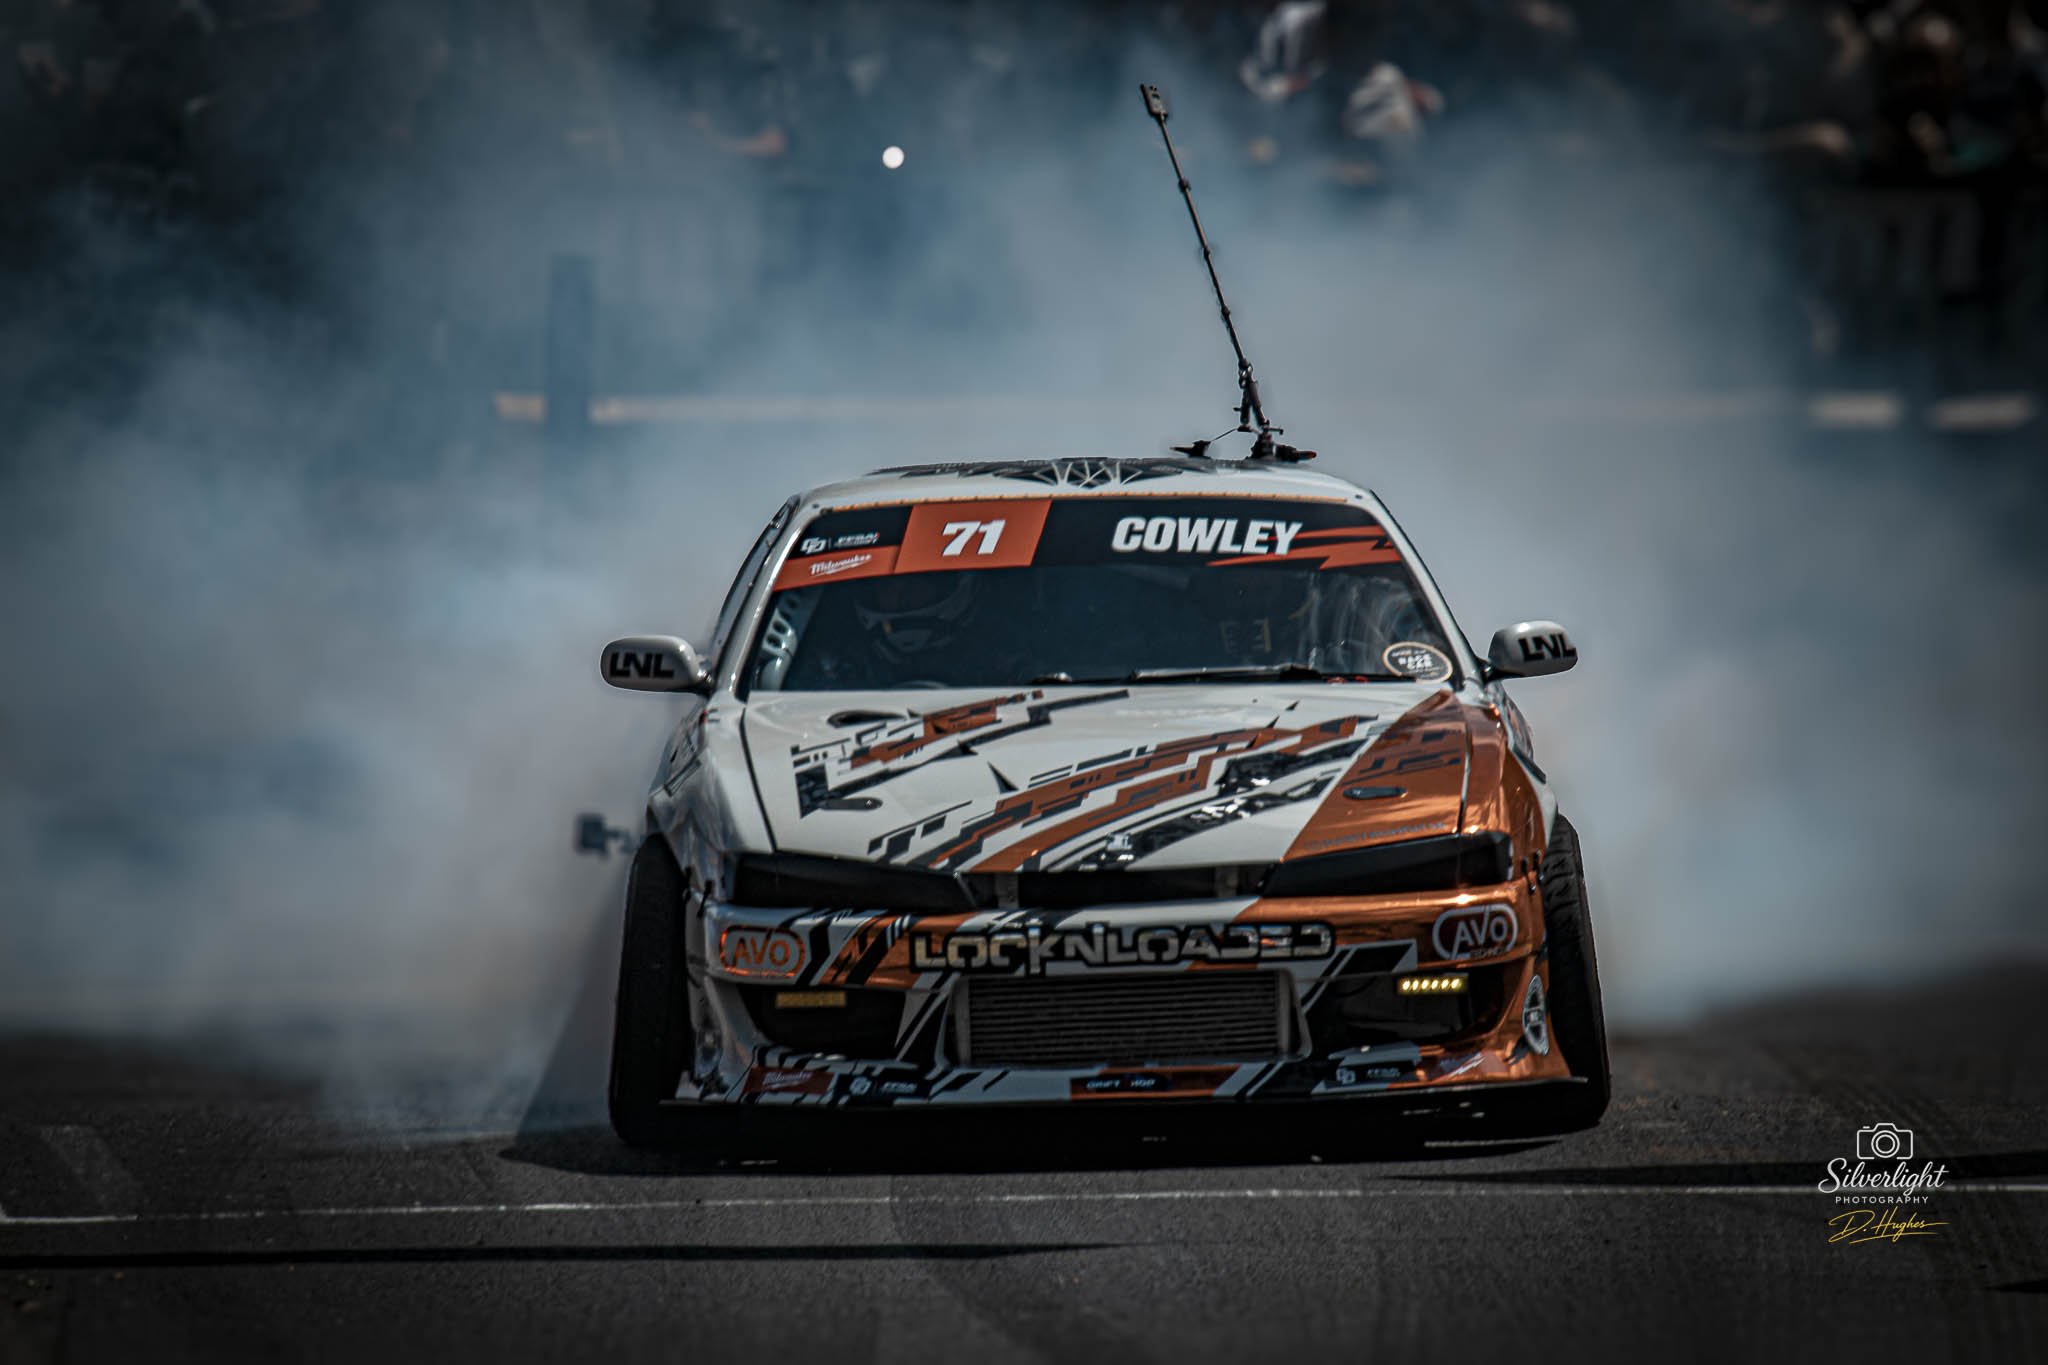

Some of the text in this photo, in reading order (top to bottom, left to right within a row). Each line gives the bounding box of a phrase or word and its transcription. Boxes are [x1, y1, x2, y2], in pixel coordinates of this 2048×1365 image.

[942, 519, 1006, 556] 71
[1111, 517, 1303, 555] COWLEY
[609, 652, 675, 678] LNL
[1518, 632, 1577, 662] LNL
[733, 929, 790, 966] AVO
[1452, 907, 1508, 957] AVO
